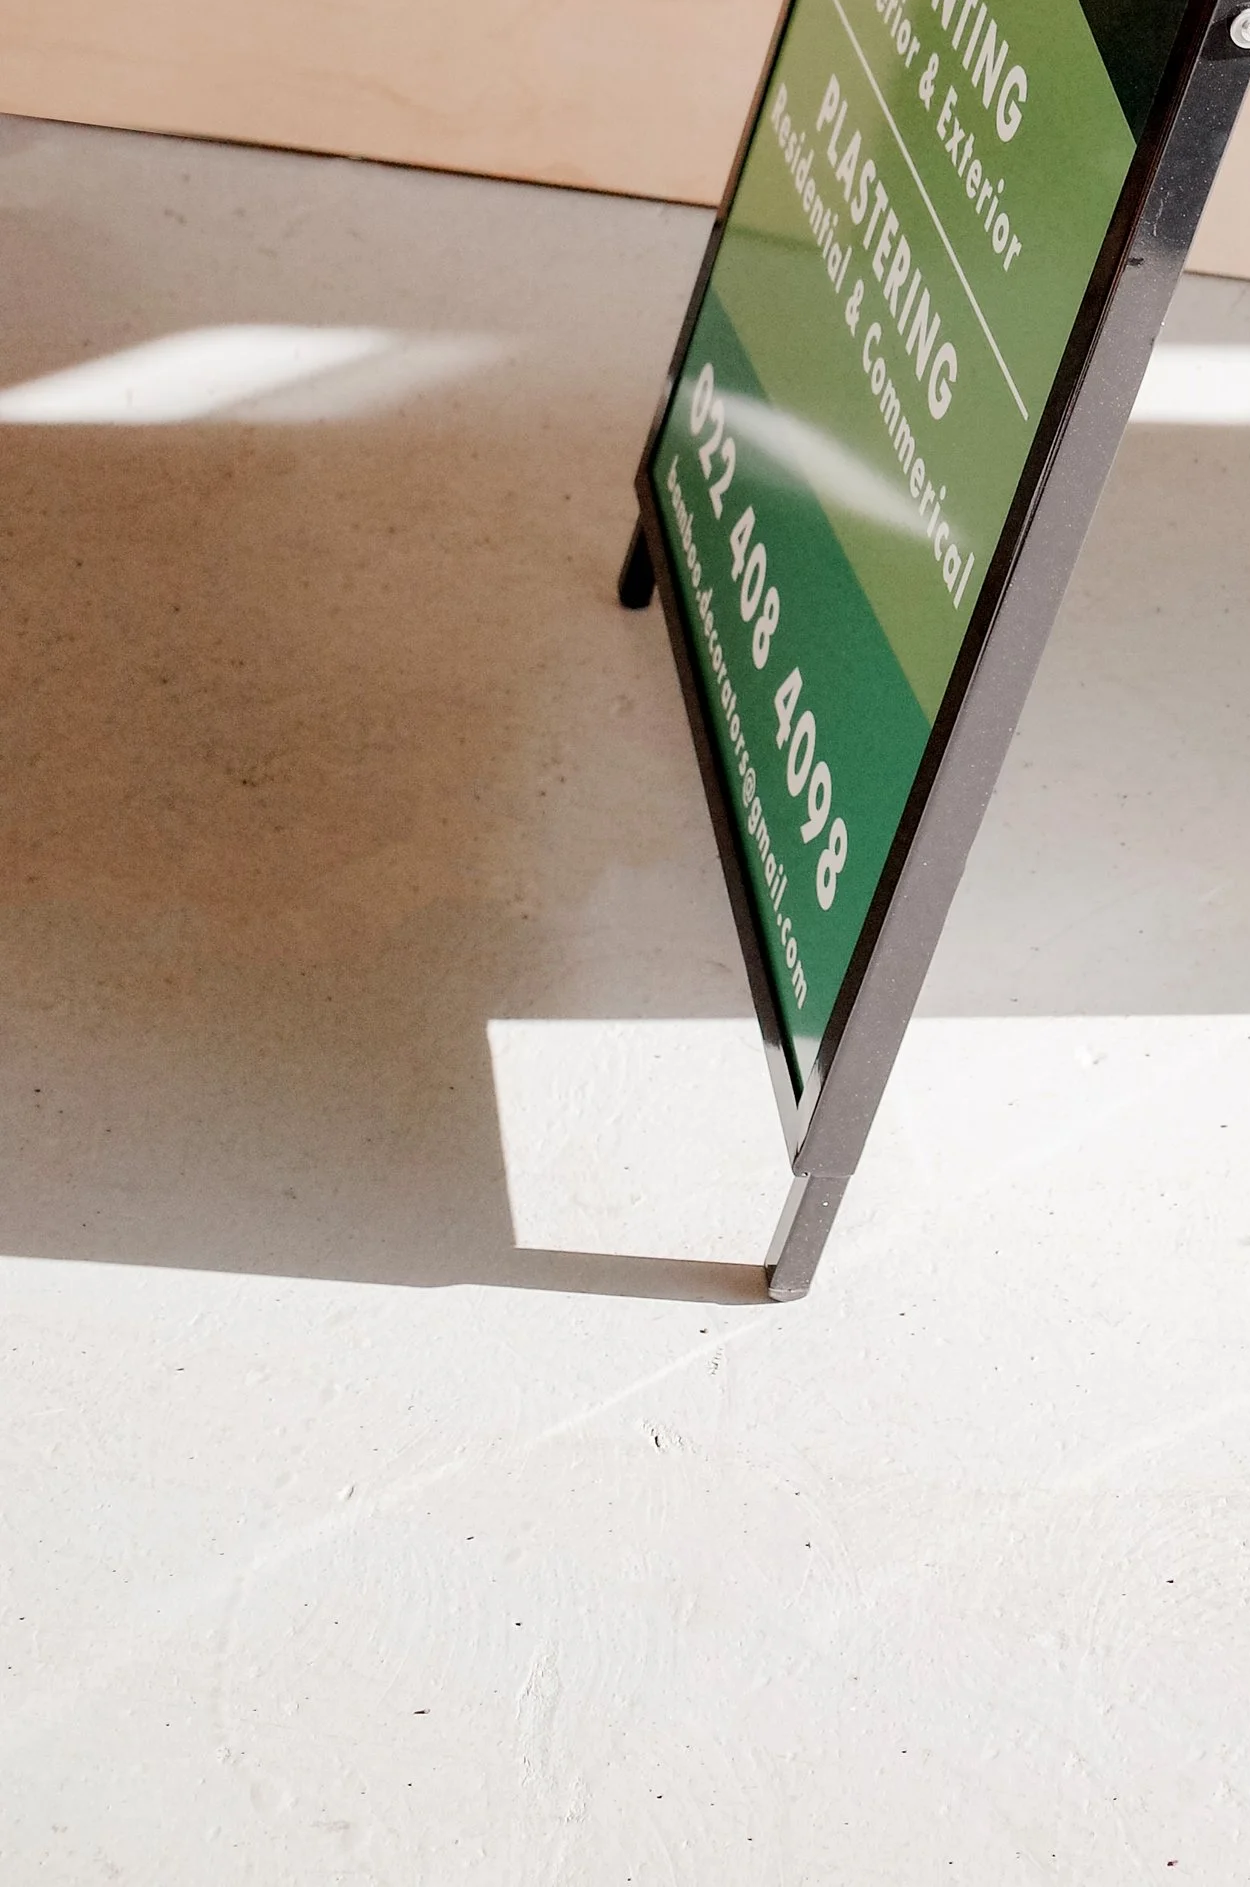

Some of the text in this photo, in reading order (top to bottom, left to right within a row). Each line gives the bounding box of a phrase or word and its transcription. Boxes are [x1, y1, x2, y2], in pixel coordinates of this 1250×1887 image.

[771, 82, 975, 610] Residential & Commerical
[816, 73, 958, 420] PLASTERING
[919, 53, 939, 111] &
[936, 86, 1022, 272] Exterior
[667, 455, 808, 1010] bamboo.decorators@gmail.com
[690, 363, 848, 911] 022 408 4098
